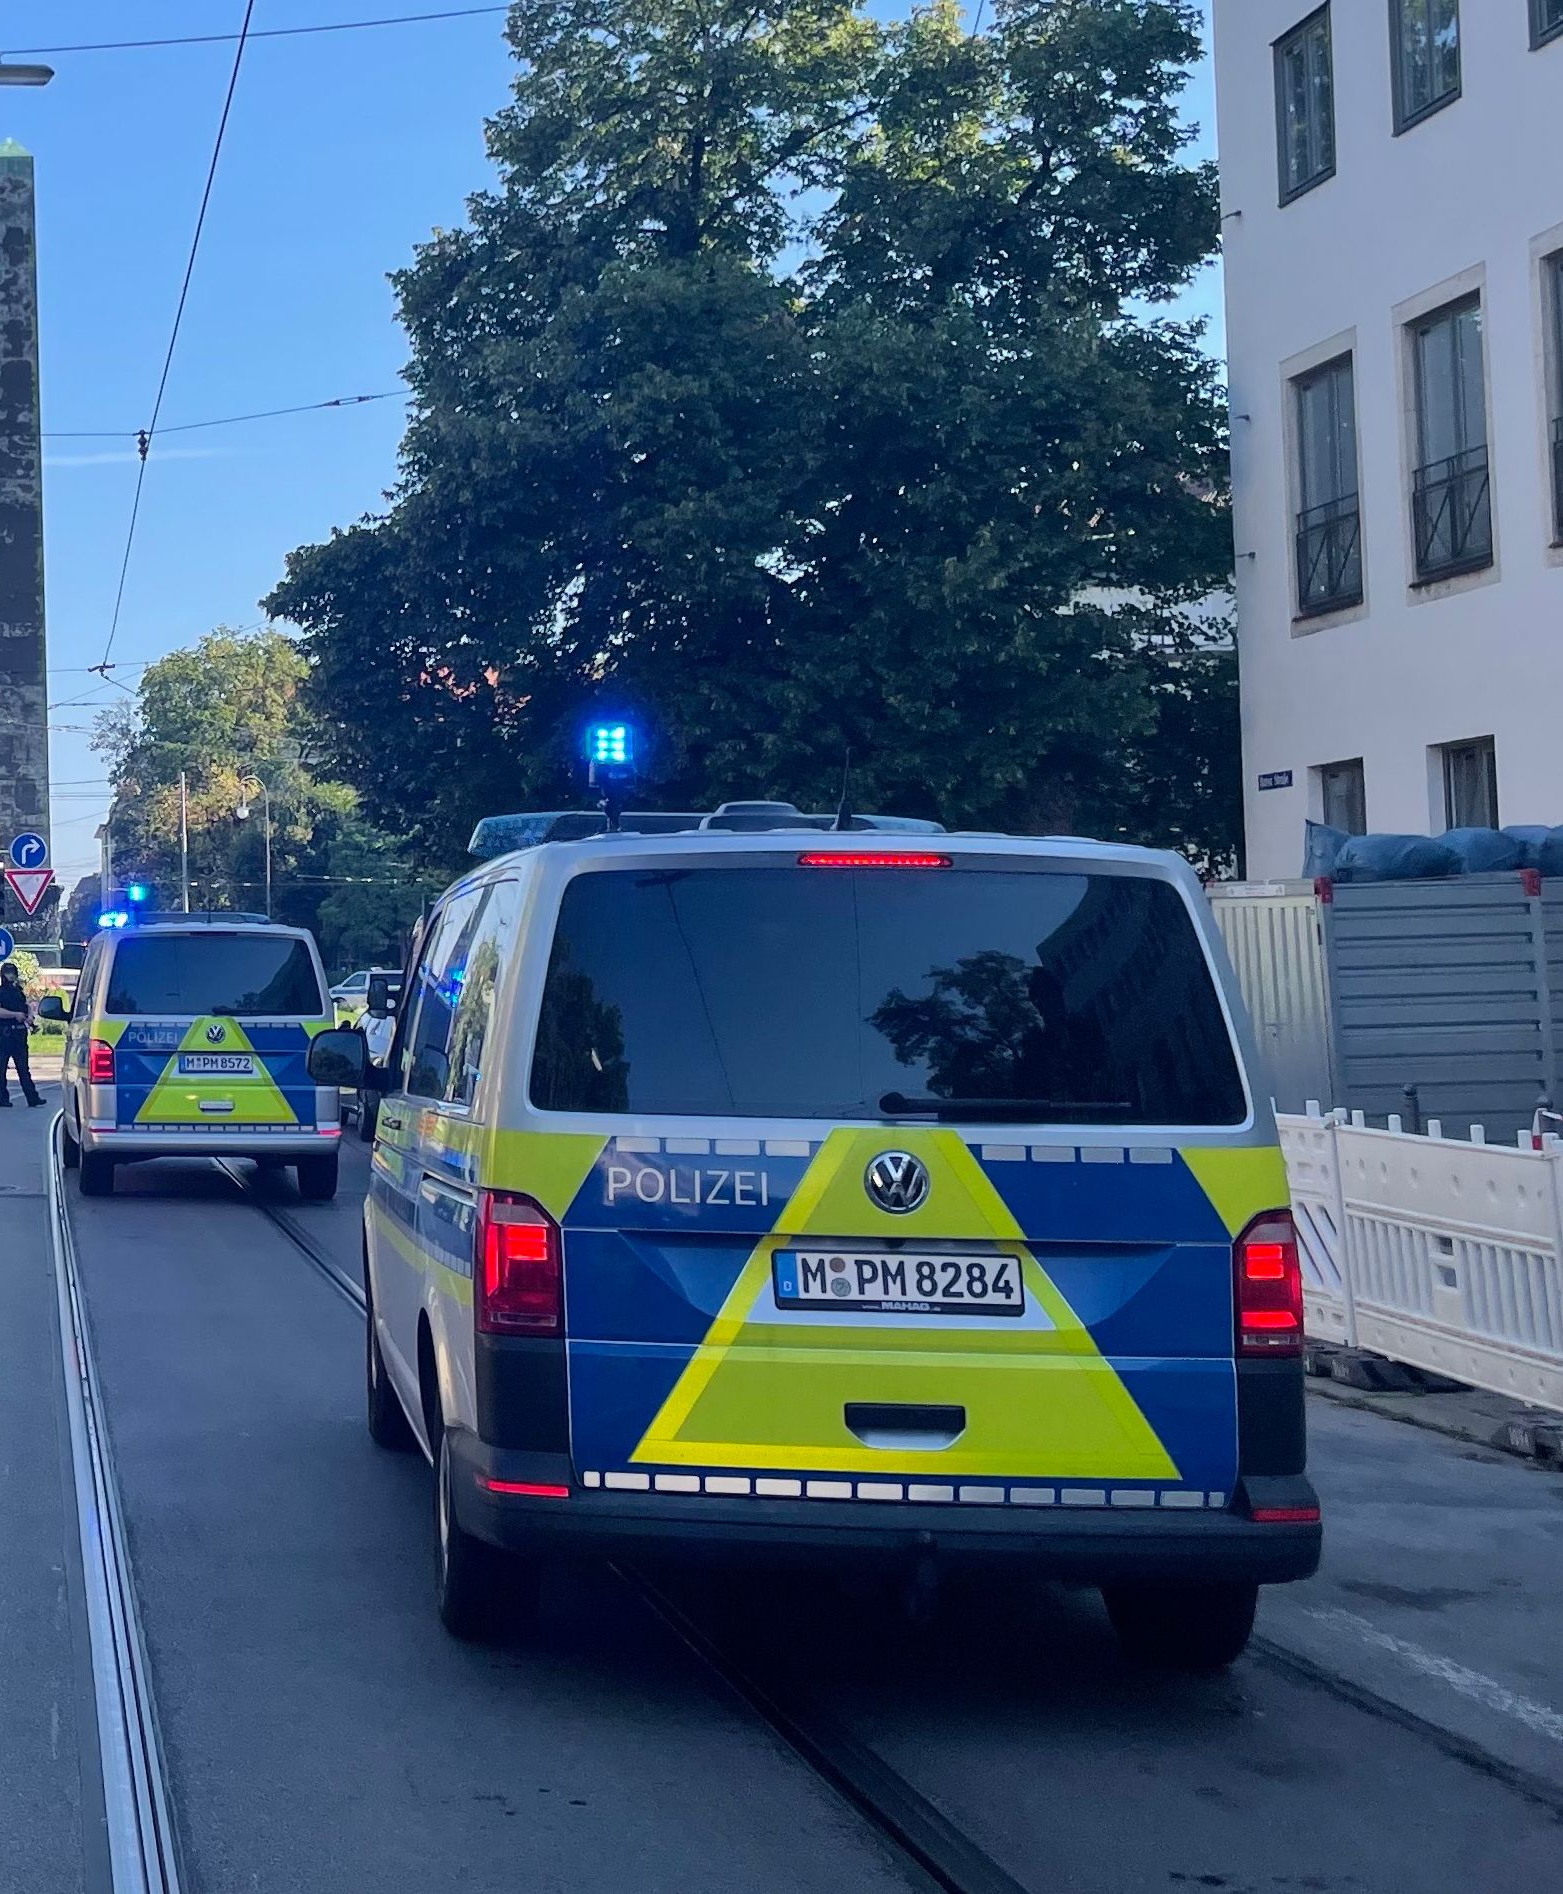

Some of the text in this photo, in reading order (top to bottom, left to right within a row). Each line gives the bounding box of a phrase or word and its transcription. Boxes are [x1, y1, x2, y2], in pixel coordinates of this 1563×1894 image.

[128, 1031, 178, 1044] POLIZEI
[186, 1057, 250, 1069] M PM 8572
[607, 1166, 768, 1206] POLIZEI
[801, 1257, 827, 1294] M
[854, 1259, 907, 1297] PM
[915, 1260, 1014, 1300] 8284
